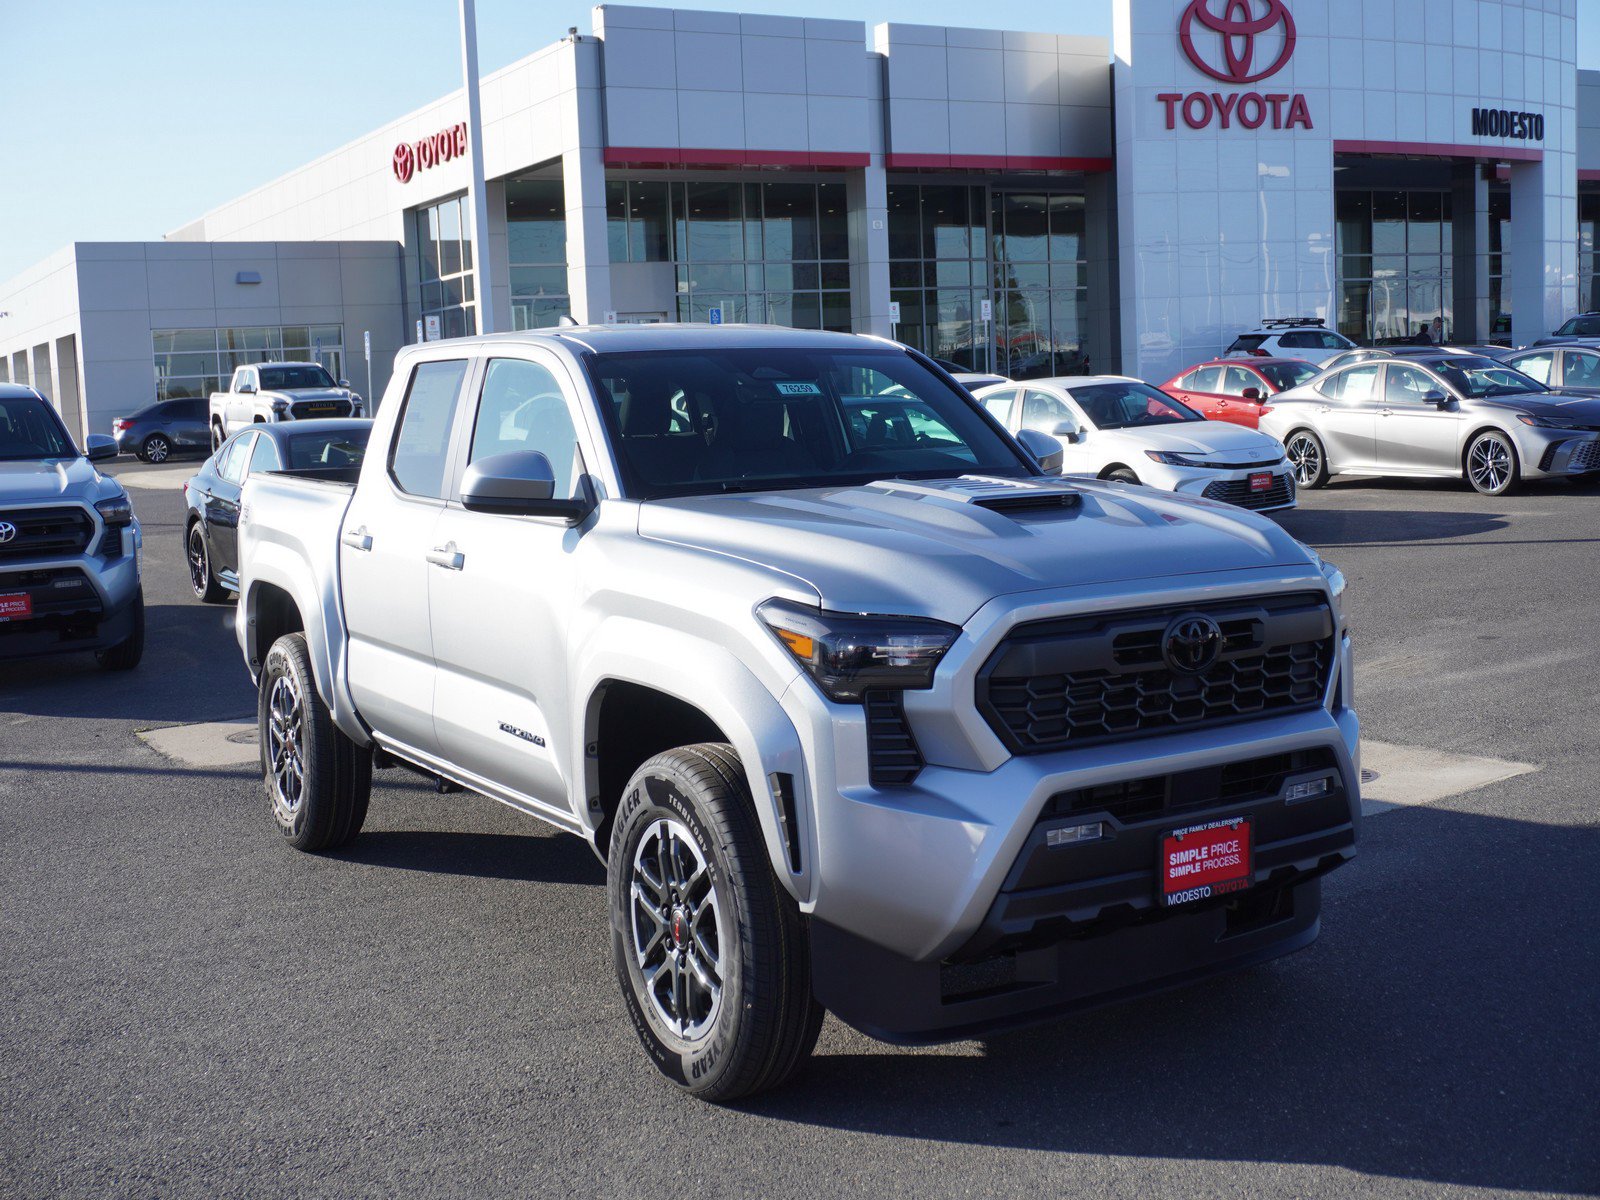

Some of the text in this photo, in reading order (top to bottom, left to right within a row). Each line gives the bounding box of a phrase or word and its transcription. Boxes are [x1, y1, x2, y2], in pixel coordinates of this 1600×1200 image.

[1157, 91, 1313, 129] TOYOTA
[1472, 107, 1544, 141] MODESTO
[413, 122, 468, 172] TOYOTA
[498, 720, 545, 748] TACOMA
[668, 794, 707, 852] TERRITORY
[1172, 817, 1243, 836] PRICE FAMILY DEALERSHIPS
[1170, 840, 1241, 865] SIMPLE PRICE.
[1170, 854, 1241, 878] SIMPLE PROCESS.
[1167, 879, 1248, 906] MODESTO TOYOTA
